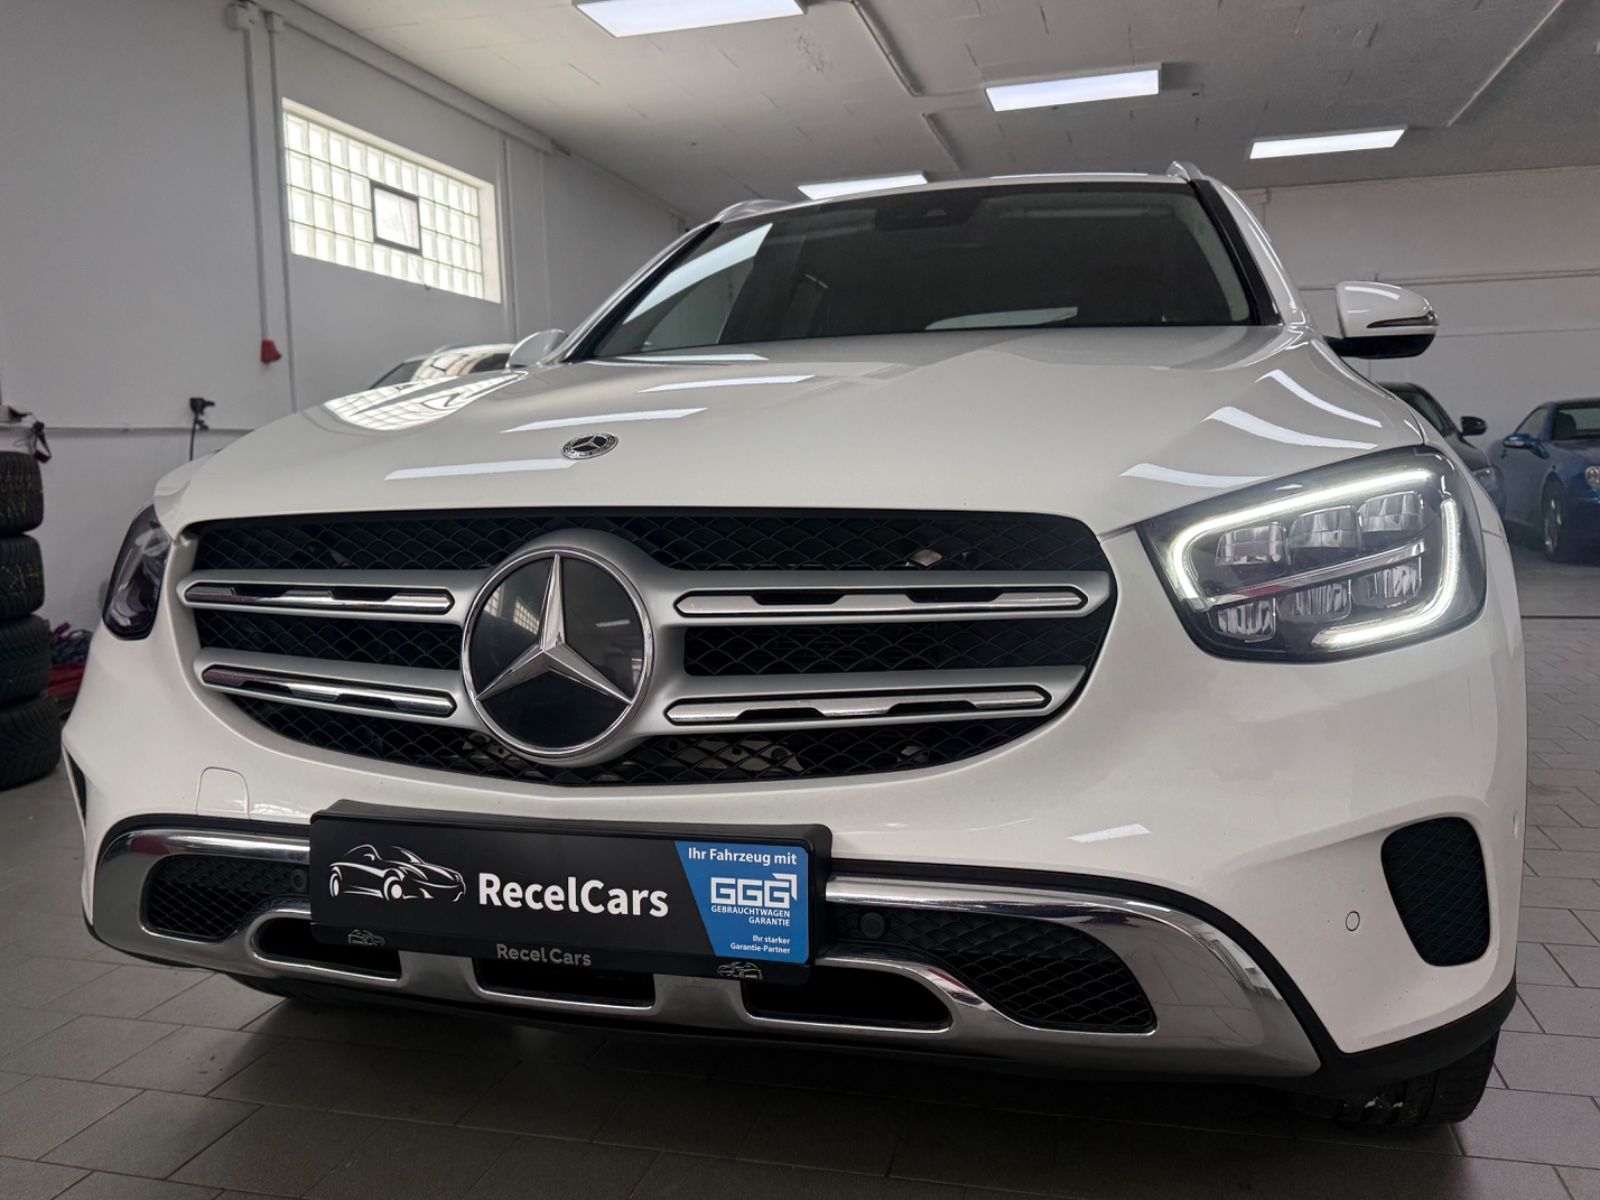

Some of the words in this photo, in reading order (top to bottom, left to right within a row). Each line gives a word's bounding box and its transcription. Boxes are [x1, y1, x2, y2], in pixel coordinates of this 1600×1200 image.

[687, 847, 706, 860] Ihr
[709, 848, 771, 867] Fahrzeug
[774, 853, 797, 866] mit
[478, 872, 669, 918] RecelCars
[710, 876, 790, 908] GGG
[710, 904, 791, 917] GEBRAUCHTWAGEN
[748, 916, 791, 927] GARANTIE
[752, 934, 763, 943] Ihr
[764, 935, 790, 944] starker
[729, 942, 790, 954] Garantie-Partner
